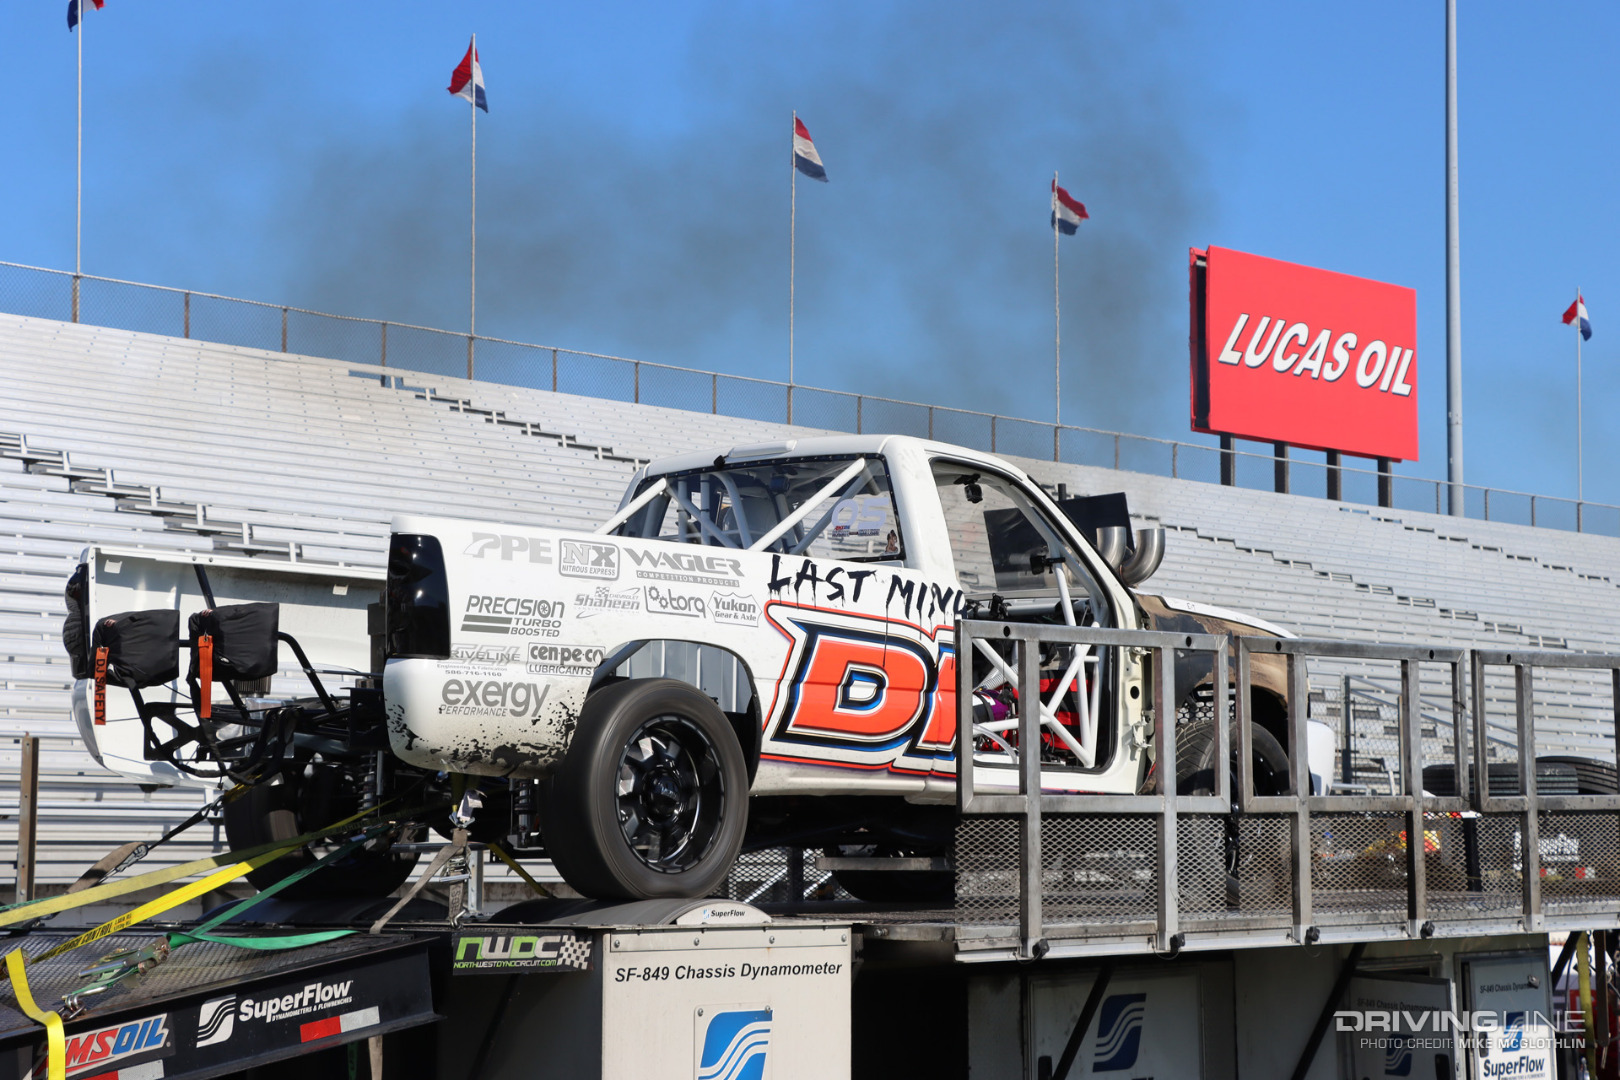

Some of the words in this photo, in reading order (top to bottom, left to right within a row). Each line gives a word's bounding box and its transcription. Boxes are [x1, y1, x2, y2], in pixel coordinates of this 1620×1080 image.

[1218, 313, 1358, 382] LUCAS
[1356, 340, 1413, 397] OIL
[832, 497, 889, 529] 05
[463, 532, 553, 564] PPE
[563, 542, 616, 568] NX
[562, 564, 588, 574] NITROUS
[589, 567, 616, 577] EXPRESS
[623, 547, 745, 577] WAGLER
[637, 571, 694, 583] COMPETITION
[697, 577, 739, 587] PRODUCTS
[767, 554, 877, 606] LAST
[574, 593, 640, 610] Shaheen
[714, 597, 756, 613] Yukon
[513, 617, 562, 628] TURBO
[715, 611, 732, 619] Gear
[510, 627, 560, 637] BOOSTED
[449, 649, 520, 662] RIVELINE
[96, 658, 105, 673] DJ
[529, 665, 592, 675] LUBRICANTS
[95, 677, 105, 722] SAFETY
[442, 679, 551, 717] exergy
[441, 704, 508, 717] PERFORMANCE
[711, 909, 746, 917] SuperFlow
[453, 960, 557, 968] NORTHWESTDYNOCIRCUIT.COM
[615, 966, 670, 982] SF-849
[675, 964, 735, 980] Chassis
[741, 961, 842, 980] Dynamometer
[239, 980, 353, 1023] SuperFlow
[272, 1007, 312, 1021] DYNAMOMETERS
[318, 996, 353, 1010] FLOWBENCHES
[1483, 1055, 1546, 1080] SuperFlow
